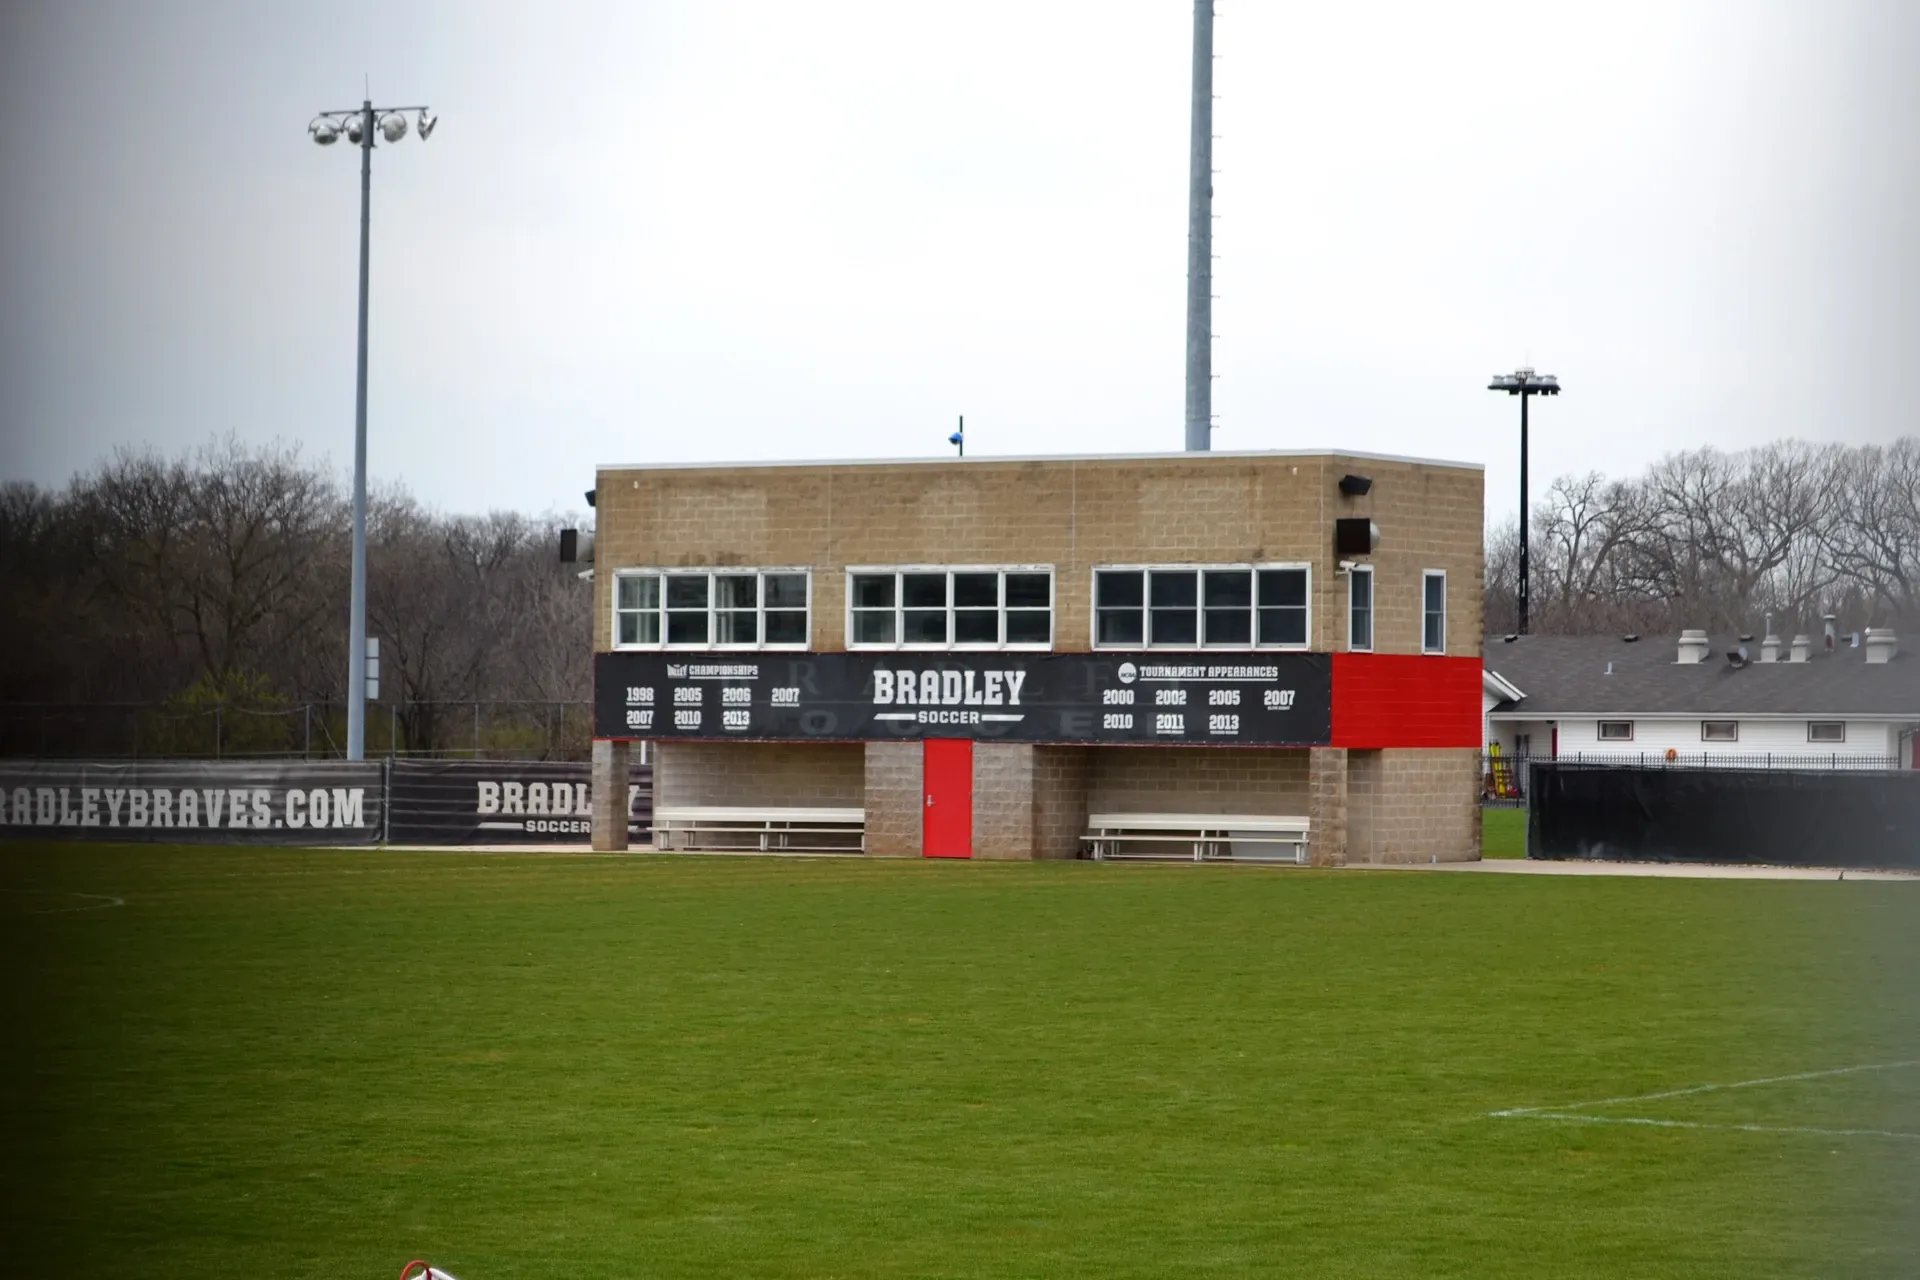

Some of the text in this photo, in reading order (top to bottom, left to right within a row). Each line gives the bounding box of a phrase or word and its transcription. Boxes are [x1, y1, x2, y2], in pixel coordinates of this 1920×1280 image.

[689, 665, 758, 676] CHAMPIONSHIPS
[1139, 666, 1206, 677] TOURNAMENT
[1208, 666, 1279, 678] APPEARANCES
[626, 687, 800, 702] 1998 2005 2006 2007
[873, 670, 1027, 705] BRADLEY
[1103, 689, 1295, 706] 2000 2002 2005 2007
[626, 710, 750, 725] 2007 2010 2013
[918, 711, 980, 724] SOCCER
[1103, 714, 1240, 730] 2010 2011 2013
[526, 819, 591, 834] SOCCER
